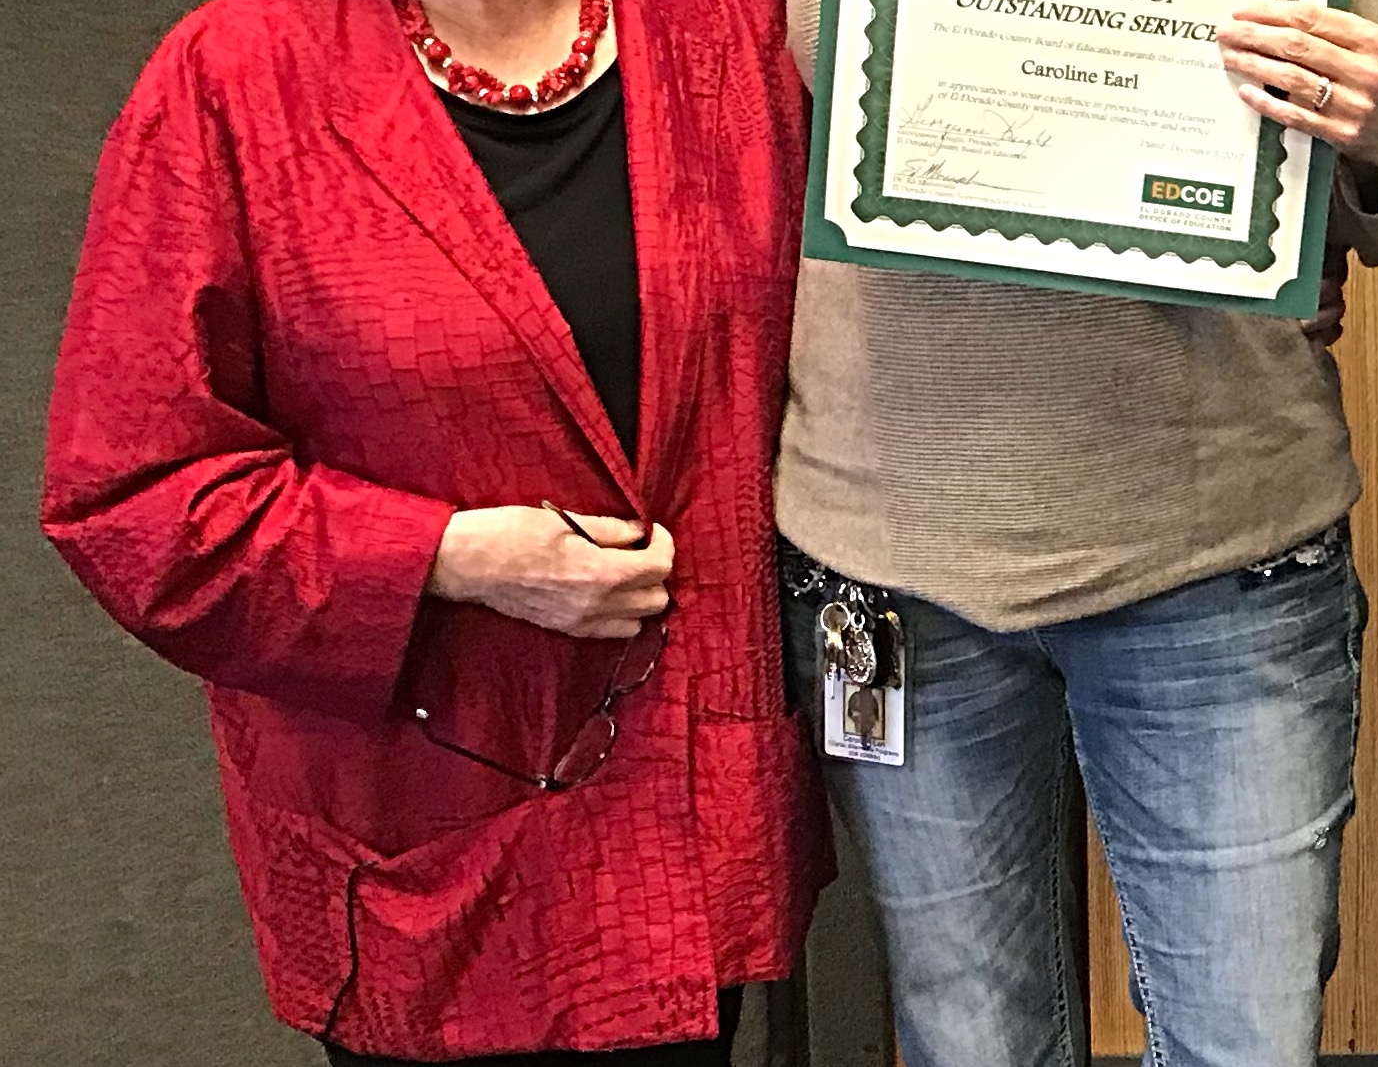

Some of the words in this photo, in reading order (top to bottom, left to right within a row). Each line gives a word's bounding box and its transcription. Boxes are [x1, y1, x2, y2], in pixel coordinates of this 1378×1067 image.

[932, 22, 950, 34] The
[963, 26, 998, 40] Dorado
[999, 31, 1032, 45] County
[1034, 36, 1064, 49] Board
[1075, 42, 1122, 57] Education
[1123, 50, 1157, 62] awards
[1021, 59, 1099, 84] Caroline
[1103, 70, 1139, 90] Earl
[960, 93, 996, 106] Dorado
[996, 98, 1031, 112] County
[1020, 91, 1043, 102] your
[1151, 180, 1226, 208] EDCOE
[1138, 213, 1169, 224] OFFICE
[1183, 220, 1232, 232] EDUCATION
[1139, 206, 1150, 214] EL
[1153, 208, 1191, 219] DORADO
[1194, 213, 1232, 225] COUNTY
